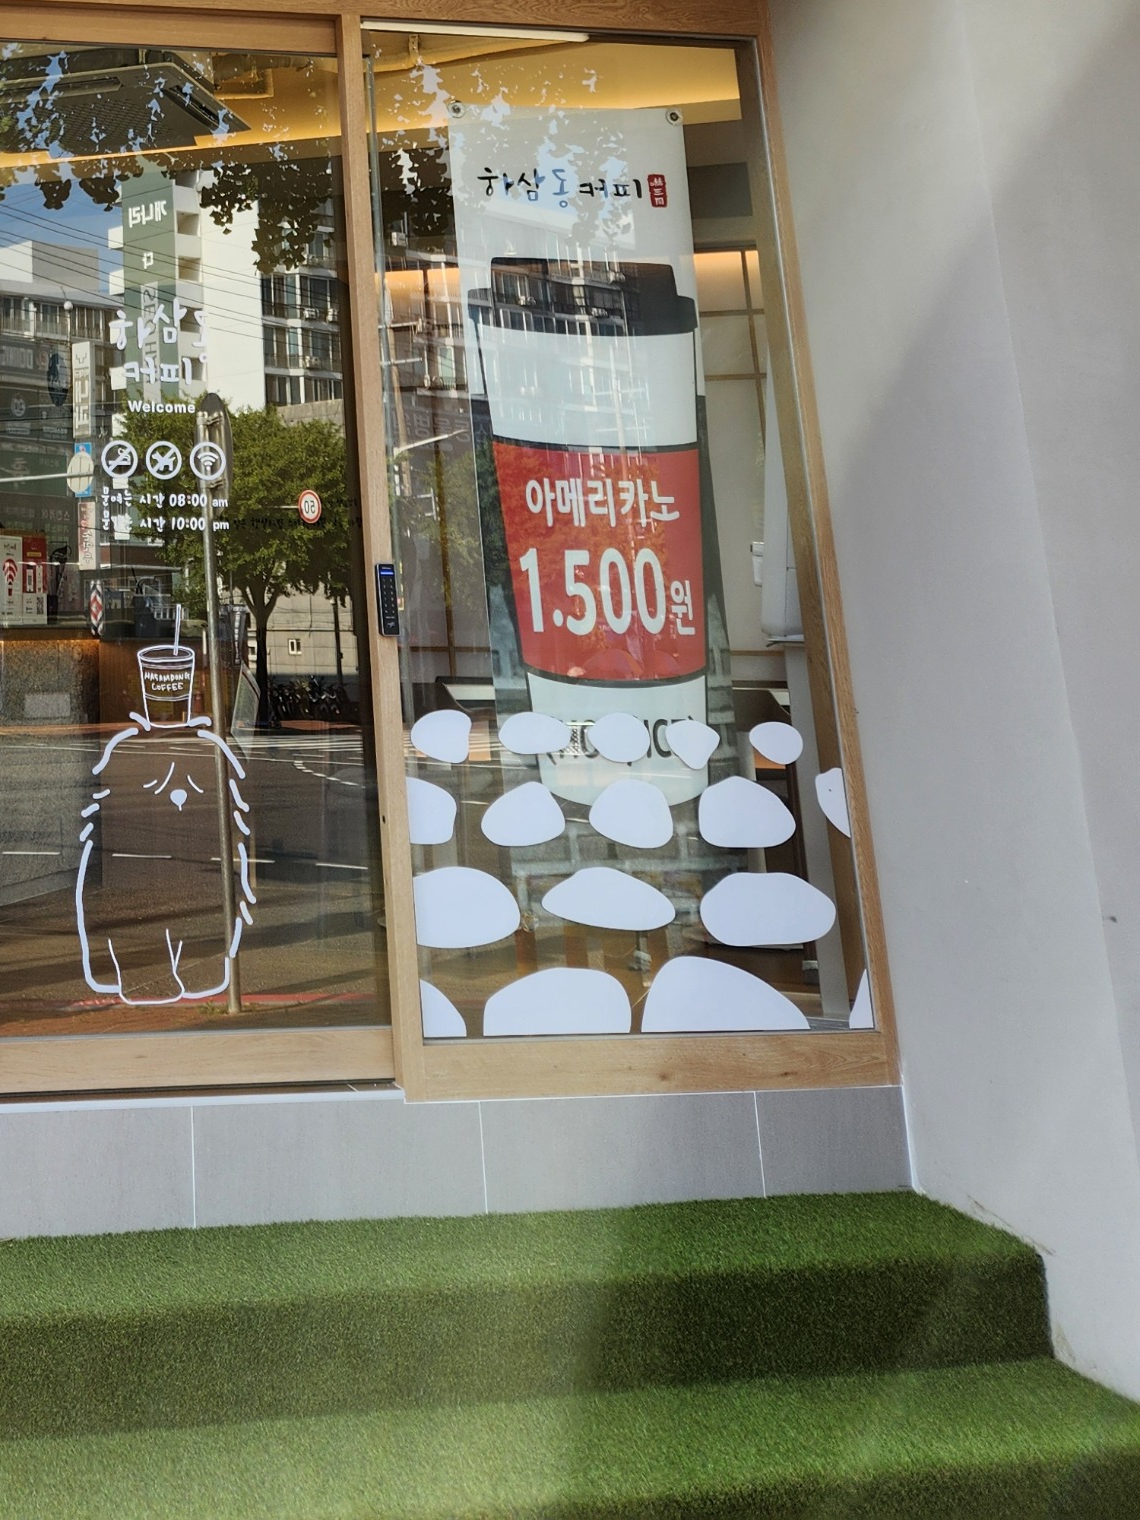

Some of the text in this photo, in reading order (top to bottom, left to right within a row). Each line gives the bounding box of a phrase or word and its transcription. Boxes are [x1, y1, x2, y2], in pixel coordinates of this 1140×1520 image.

[123, 357, 192, 385] 커피
[128, 400, 196, 414] Welcome
[139, 493, 165, 508] 시간
[169, 493, 208, 508] 08:00
[212, 499, 228, 508] am
[525, 477, 680, 527] 아메리카노
[139, 516, 165, 532] 시간
[171, 516, 207, 530] 10:00
[212, 520, 229, 532] pm
[151, 682, 184, 691] COFFEE
